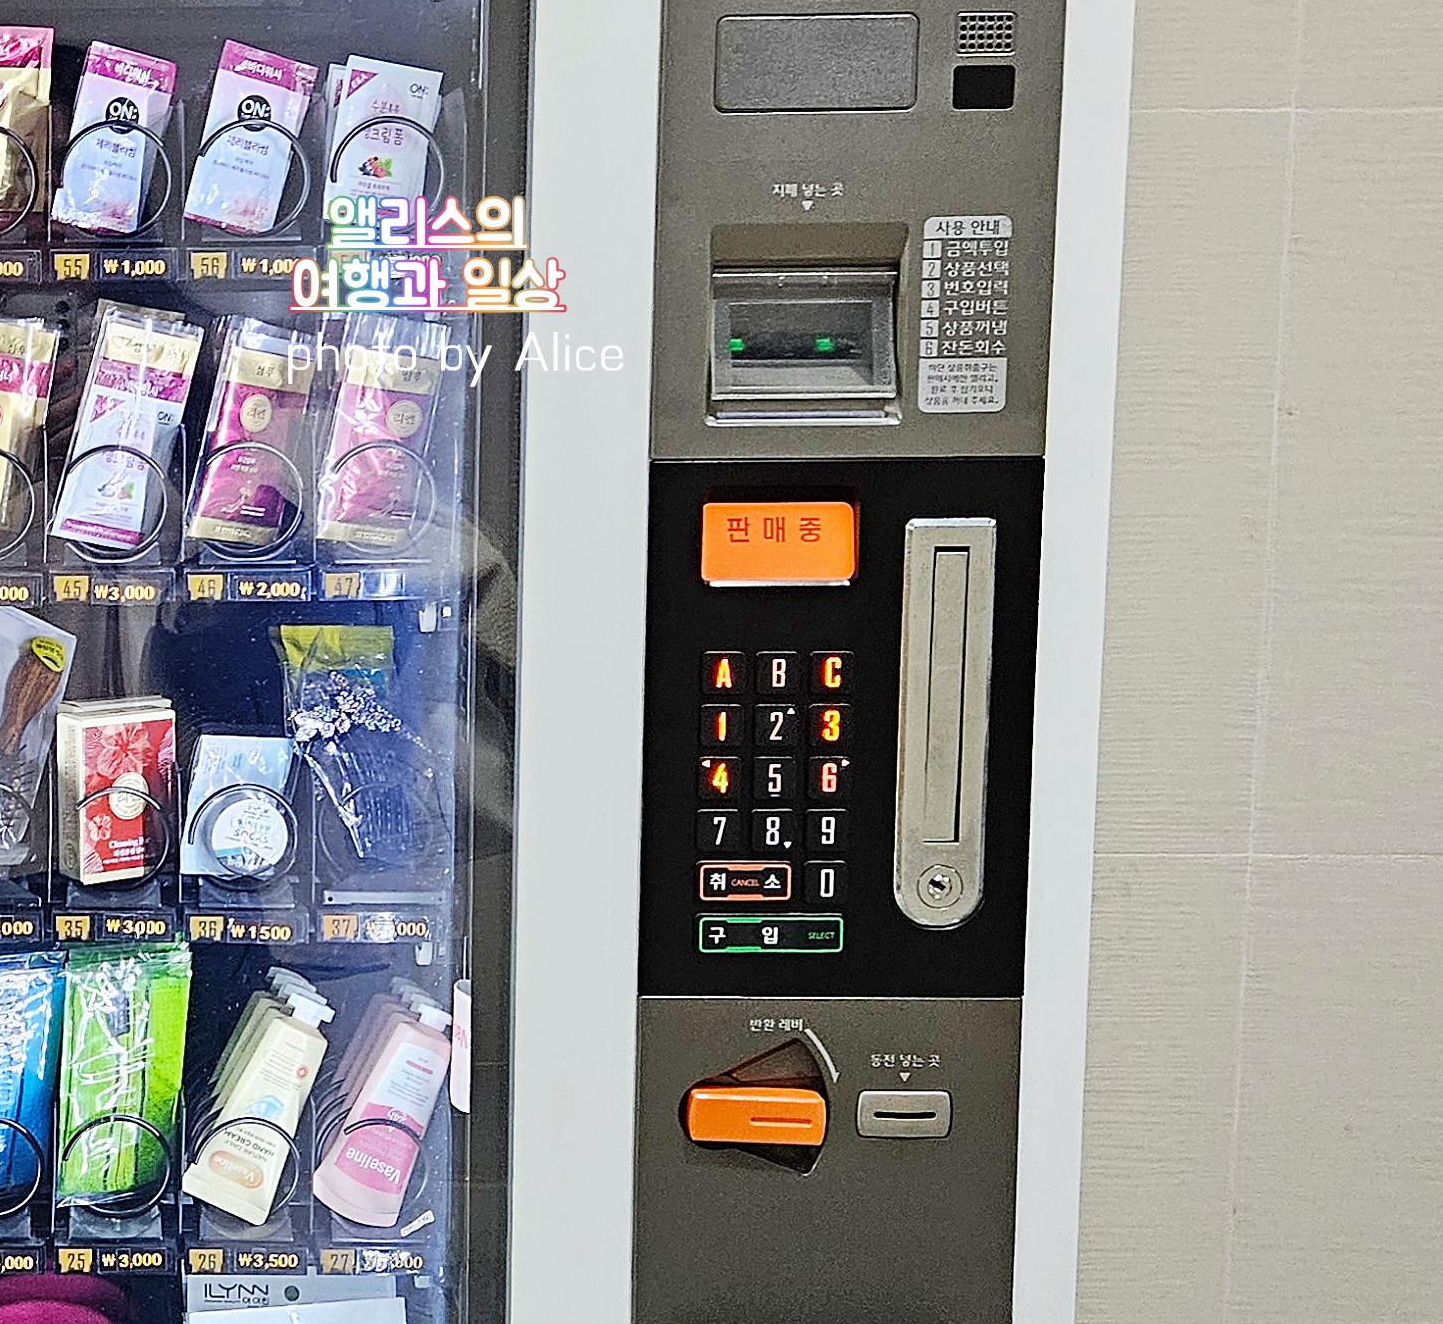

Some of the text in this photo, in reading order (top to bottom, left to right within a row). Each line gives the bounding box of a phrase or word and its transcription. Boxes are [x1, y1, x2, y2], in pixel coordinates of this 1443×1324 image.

[242, 99, 270, 118] ON:
[772, 183, 845, 198] 지폐 넣는 곳
[936, 220, 1000, 235] 사용 안내
[946, 240, 1008, 257] 금액투입
[102, 257, 166, 278] ₩1,000
[944, 261, 1009, 277] 상품선택
[944, 280, 1008, 295] 번호입력
[944, 300, 1008, 315] 구입버튼
[942, 320, 1007, 336] 상품꺼냄
[941, 339, 1007, 355] 잔돈회수
[93, 582, 155, 602] ₩3,000
[238, 578, 300, 599] ₩2,000
[715, 655, 842, 689] A B C
[716, 709, 841, 741] 1 2 3
[712, 762, 838, 793] 4 5 6
[712, 816, 836, 845] 7 8 9
[709, 871, 727, 892] 취
[763, 870, 781, 889] 소
[819, 868, 835, 899] 0
[708, 926, 835, 945] 구 입 SELECT
[749, 1019, 803, 1032] 반환 레버
[870, 1054, 941, 1068] 동전 넣는 곳
[213, 1155, 256, 1184] Vaseline
[344, 1146, 402, 1185] Vaseline
[101, 1252, 162, 1270] ₩3,000
[237, 1251, 300, 1270] ₩3,500
[205, 1283, 269, 1298] ILYNN
